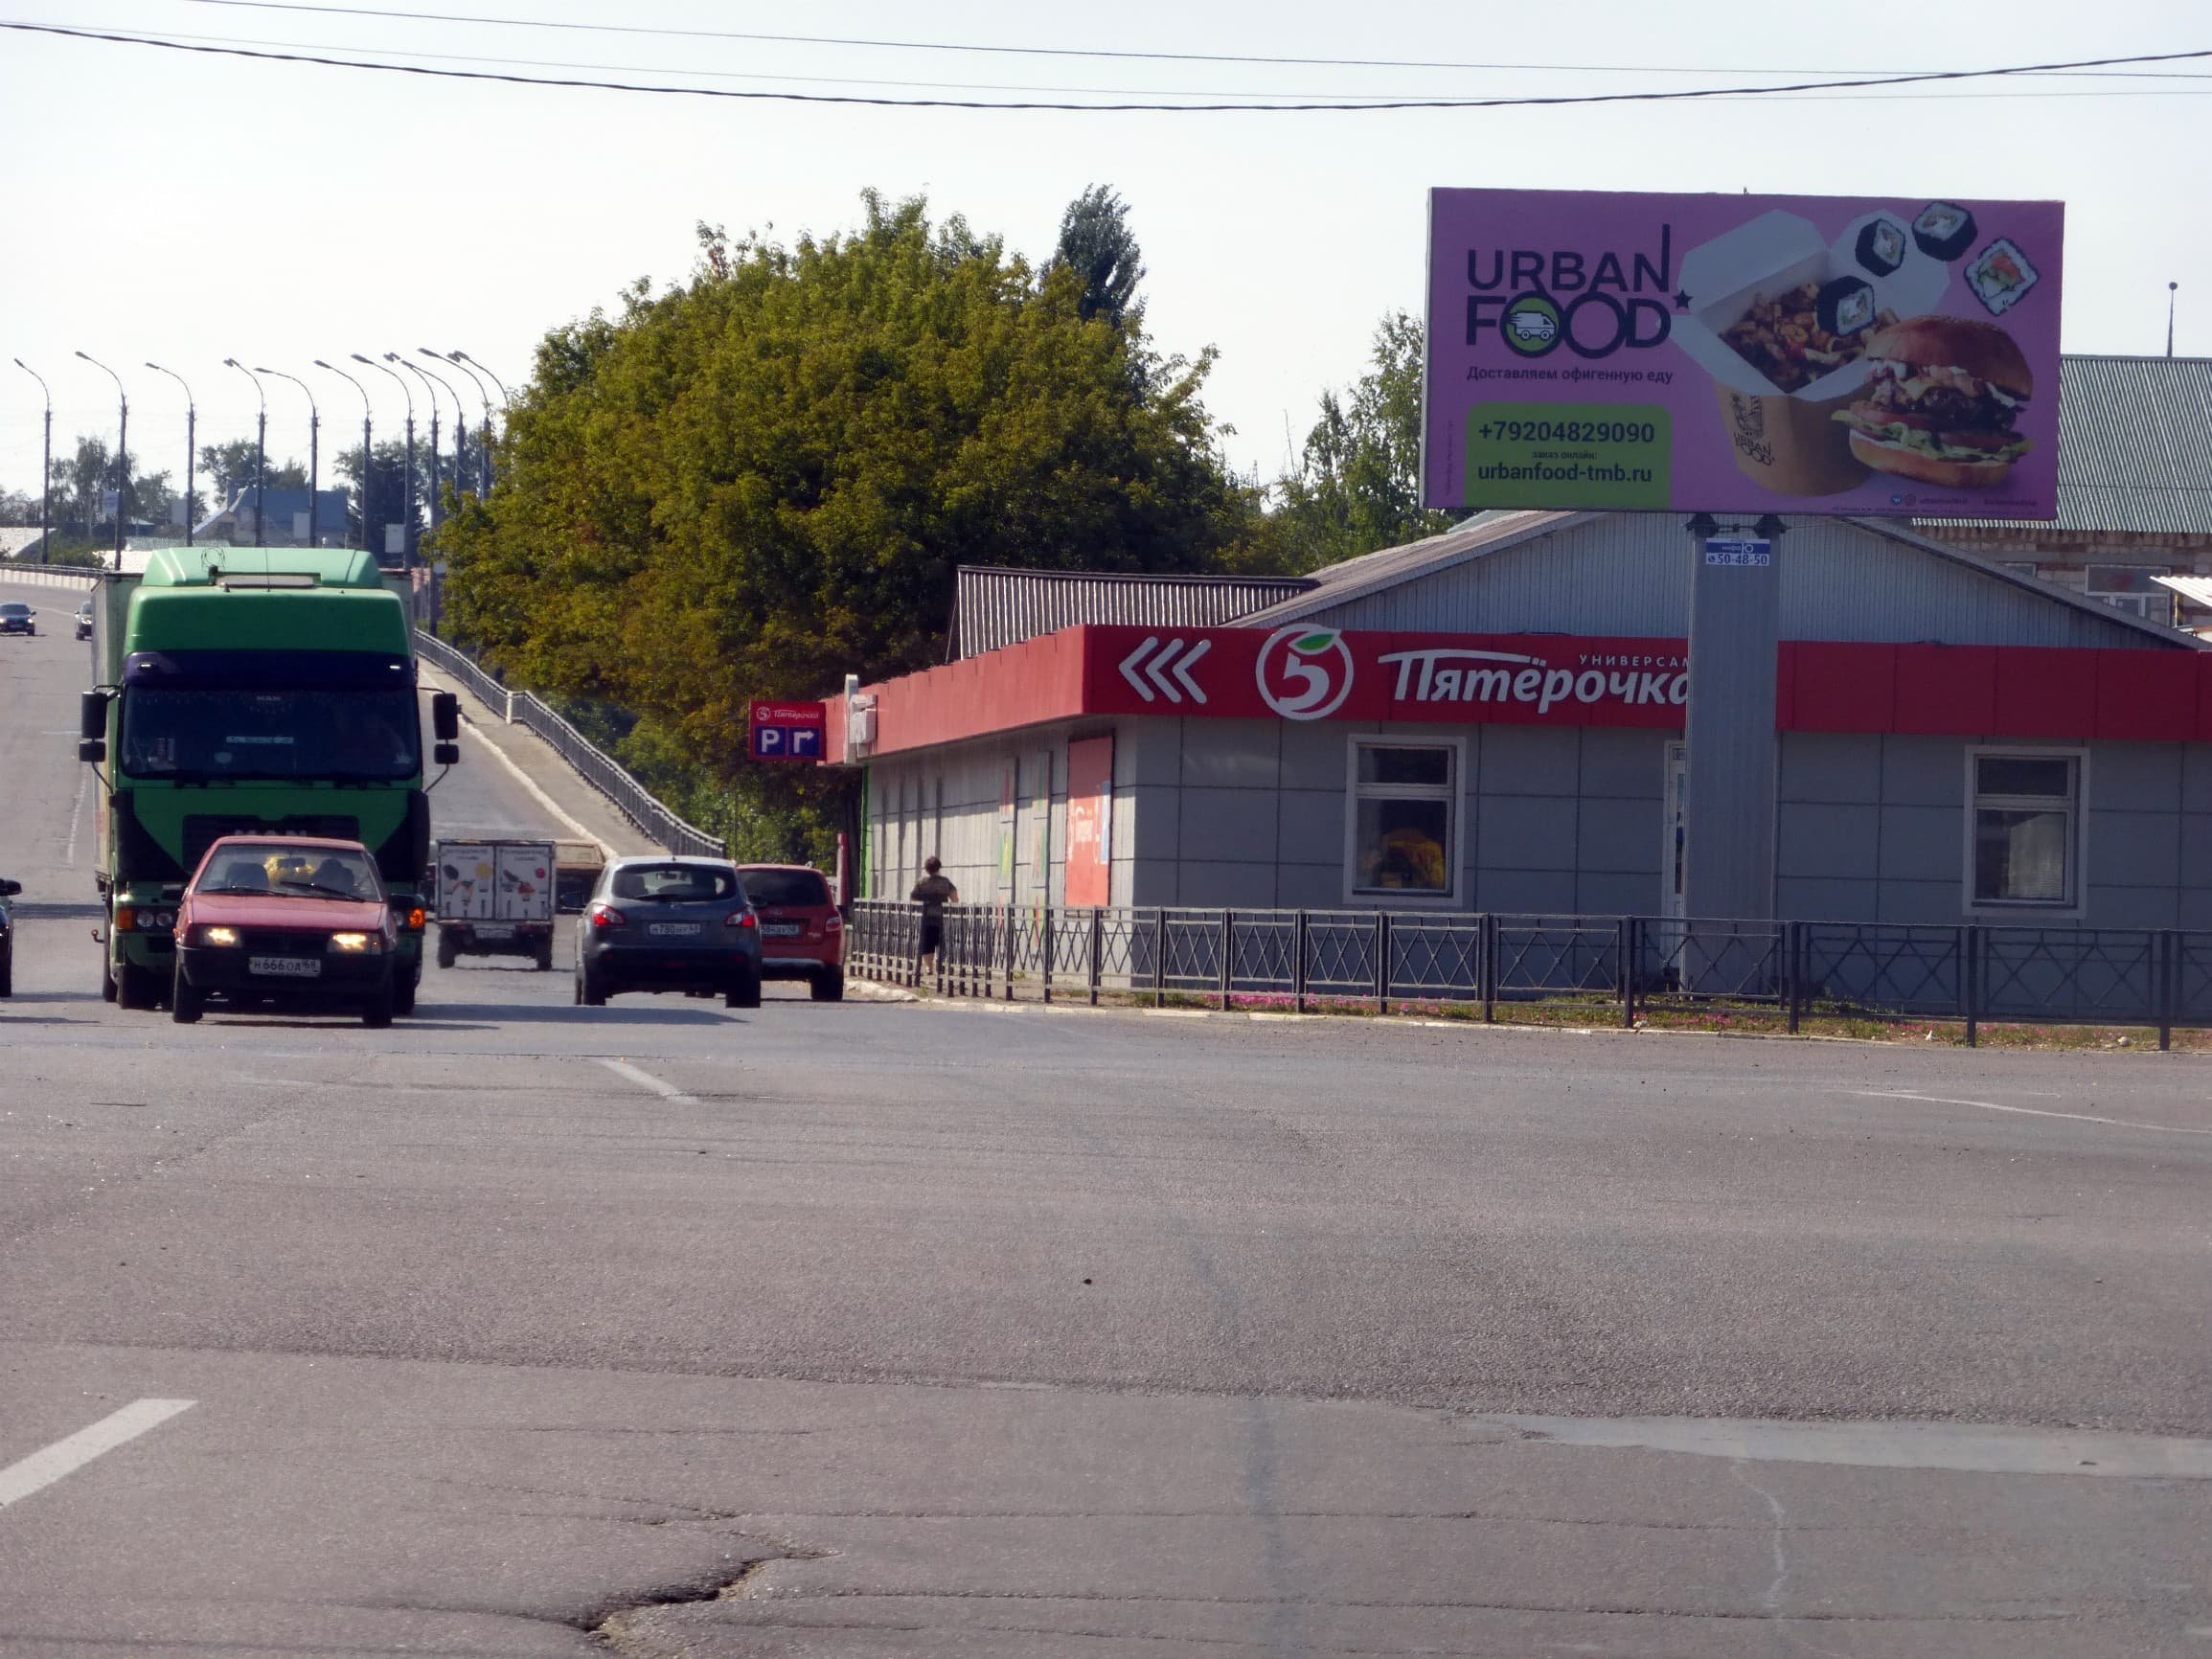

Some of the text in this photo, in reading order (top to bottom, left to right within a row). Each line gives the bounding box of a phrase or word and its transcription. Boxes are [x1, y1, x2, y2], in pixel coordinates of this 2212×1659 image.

[1467, 223, 1671, 294] URBAN
[1466, 290, 1672, 359] FOOD
[1467, 366, 1674, 385] Доставляем офигенную еду
[1478, 420, 1655, 443] +79204829090
[1532, 450, 1598, 460] заказ онлайн:
[1478, 462, 1653, 483] urbanfood-tmb.ru
[1718, 553, 1767, 565] 50-48-50
[761, 729, 780, 753] P
